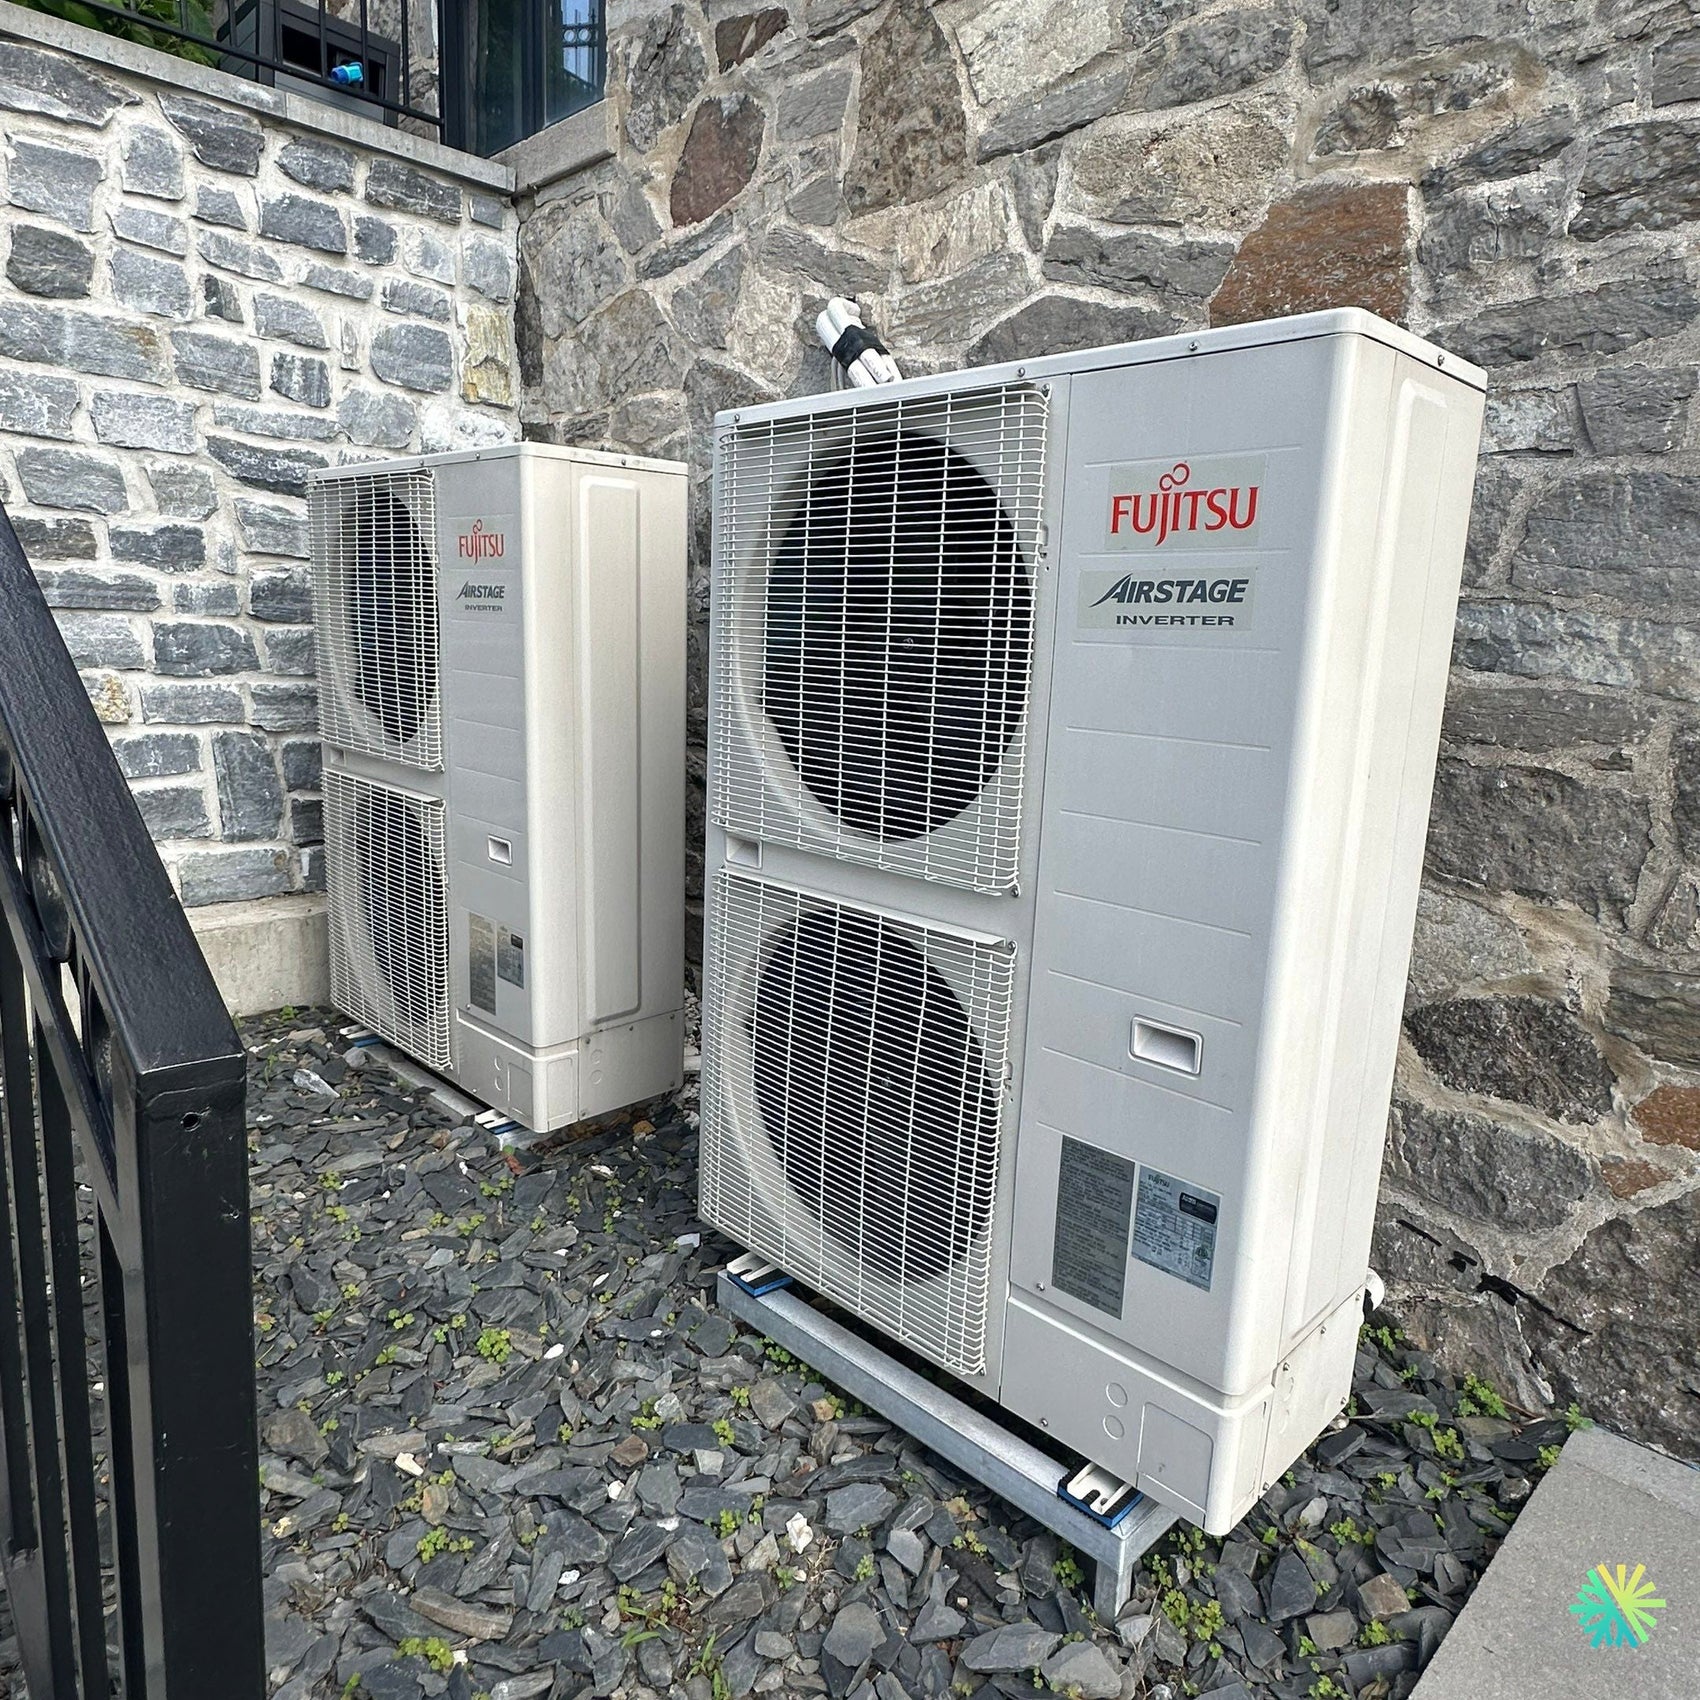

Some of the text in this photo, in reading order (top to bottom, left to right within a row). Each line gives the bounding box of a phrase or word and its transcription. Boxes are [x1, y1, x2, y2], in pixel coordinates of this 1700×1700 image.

[1110, 463, 1260, 547] FUJITSU
[458, 519, 505, 565] FUJITSU
[456, 580, 505, 601] AIRSTAGE
[1088, 572, 1249, 608] AIRSTAGE
[1116, 614, 1235, 626] INVERTER
